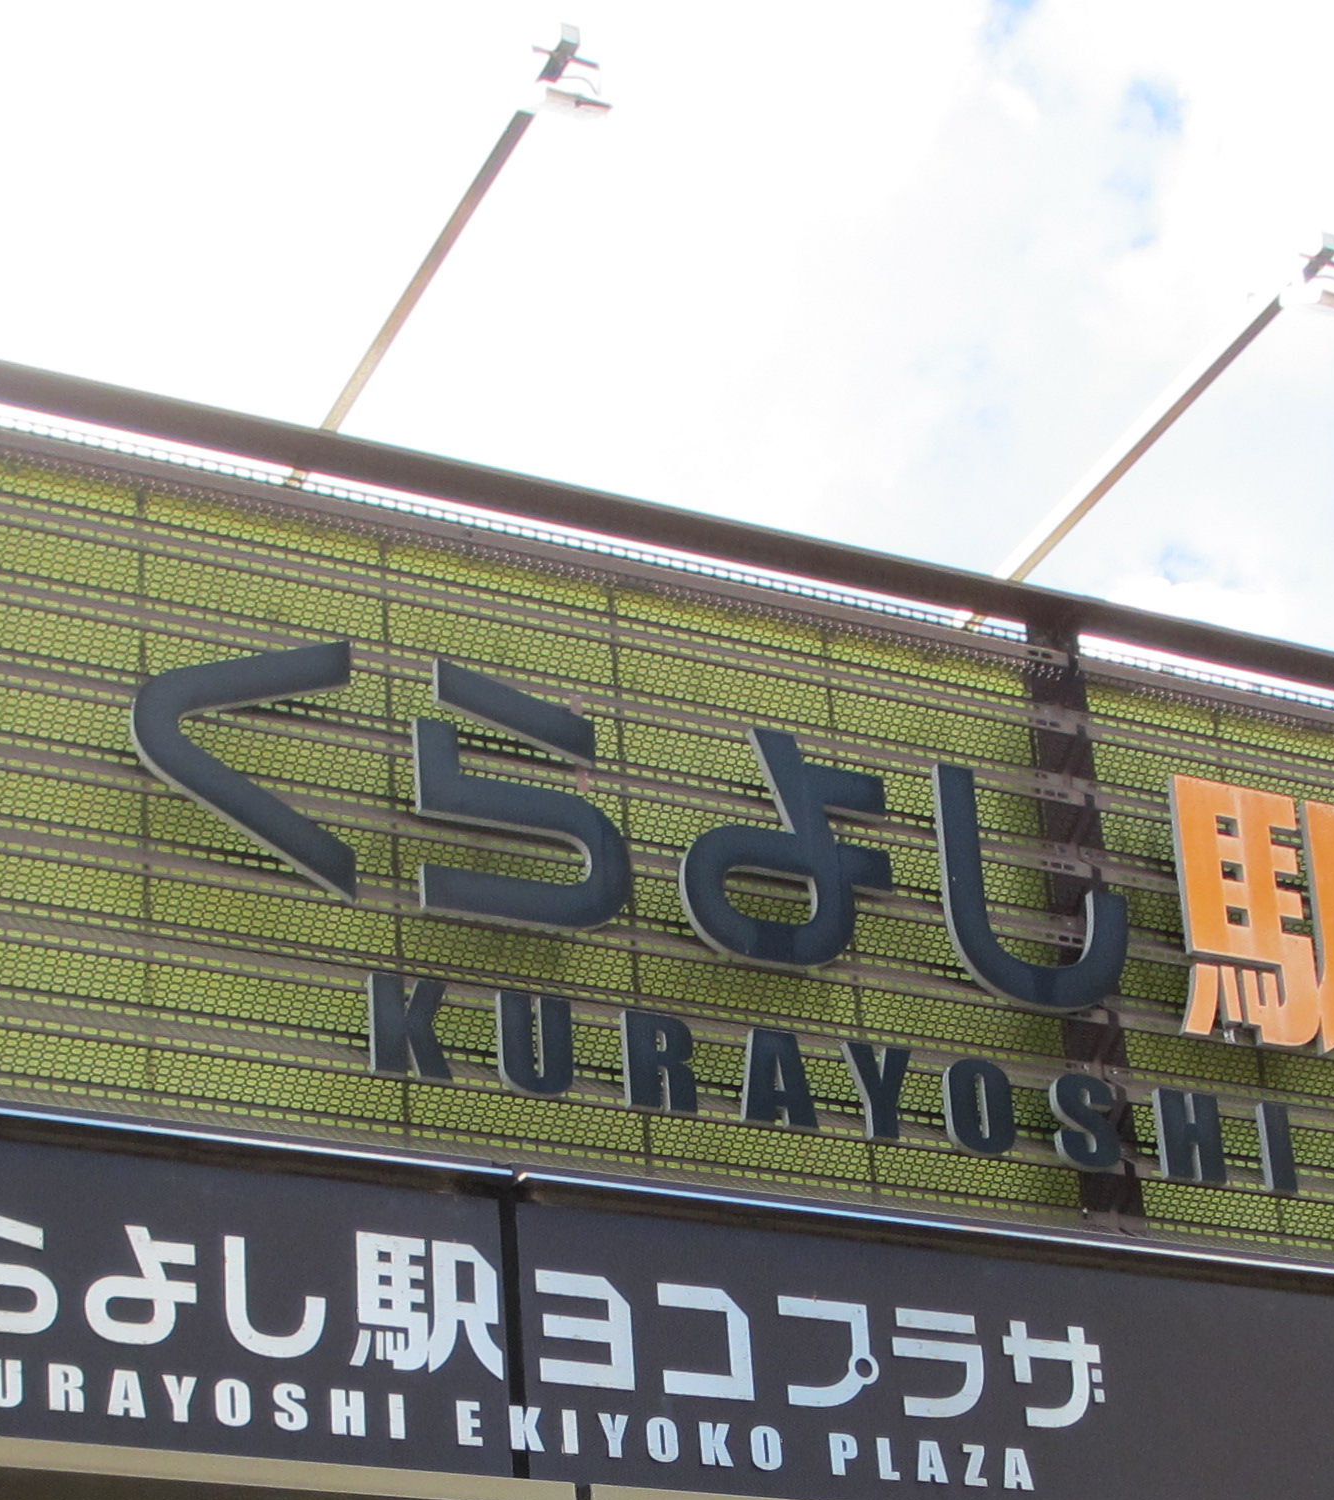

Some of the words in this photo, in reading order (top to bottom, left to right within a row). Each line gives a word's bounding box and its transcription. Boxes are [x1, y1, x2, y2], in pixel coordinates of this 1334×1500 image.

[365, 972, 1299, 1195] KURAYOSHI
[455, 1398, 784, 1474] EKIYOKO
[831, 1432, 1036, 1493] PLAZA
